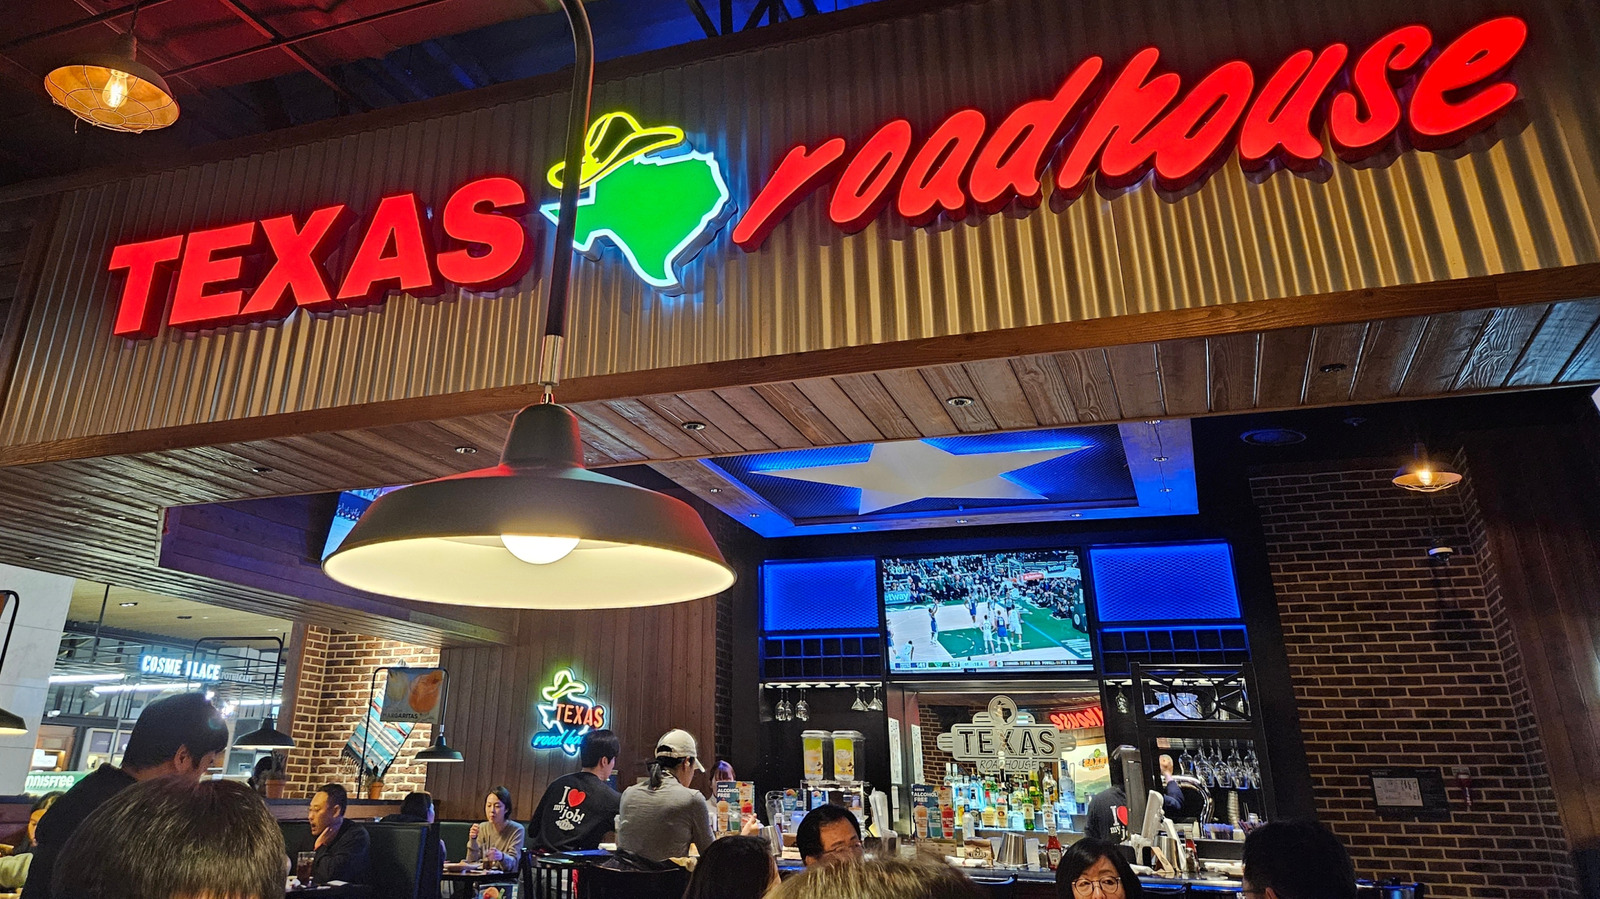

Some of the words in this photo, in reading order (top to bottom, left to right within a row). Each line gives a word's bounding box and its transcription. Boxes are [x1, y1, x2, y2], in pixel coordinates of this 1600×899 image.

[107, 176, 526, 335] TEXAS
[732, 16, 1528, 244] roadhouse
[885, 592, 909, 602] etway
[141, 655, 183, 676] COSME
[556, 703, 604, 728] TEXAS
[957, 728, 1058, 756] TEXAS
[979, 759, 1038, 771] ROAHOUSE
[559, 785, 571, 805] I
[553, 804, 566, 813] my
[559, 806, 585, 824] job!
[1110, 805, 1120, 826] I
[1110, 825, 1121, 835] my
[1121, 826, 1128, 841] j
